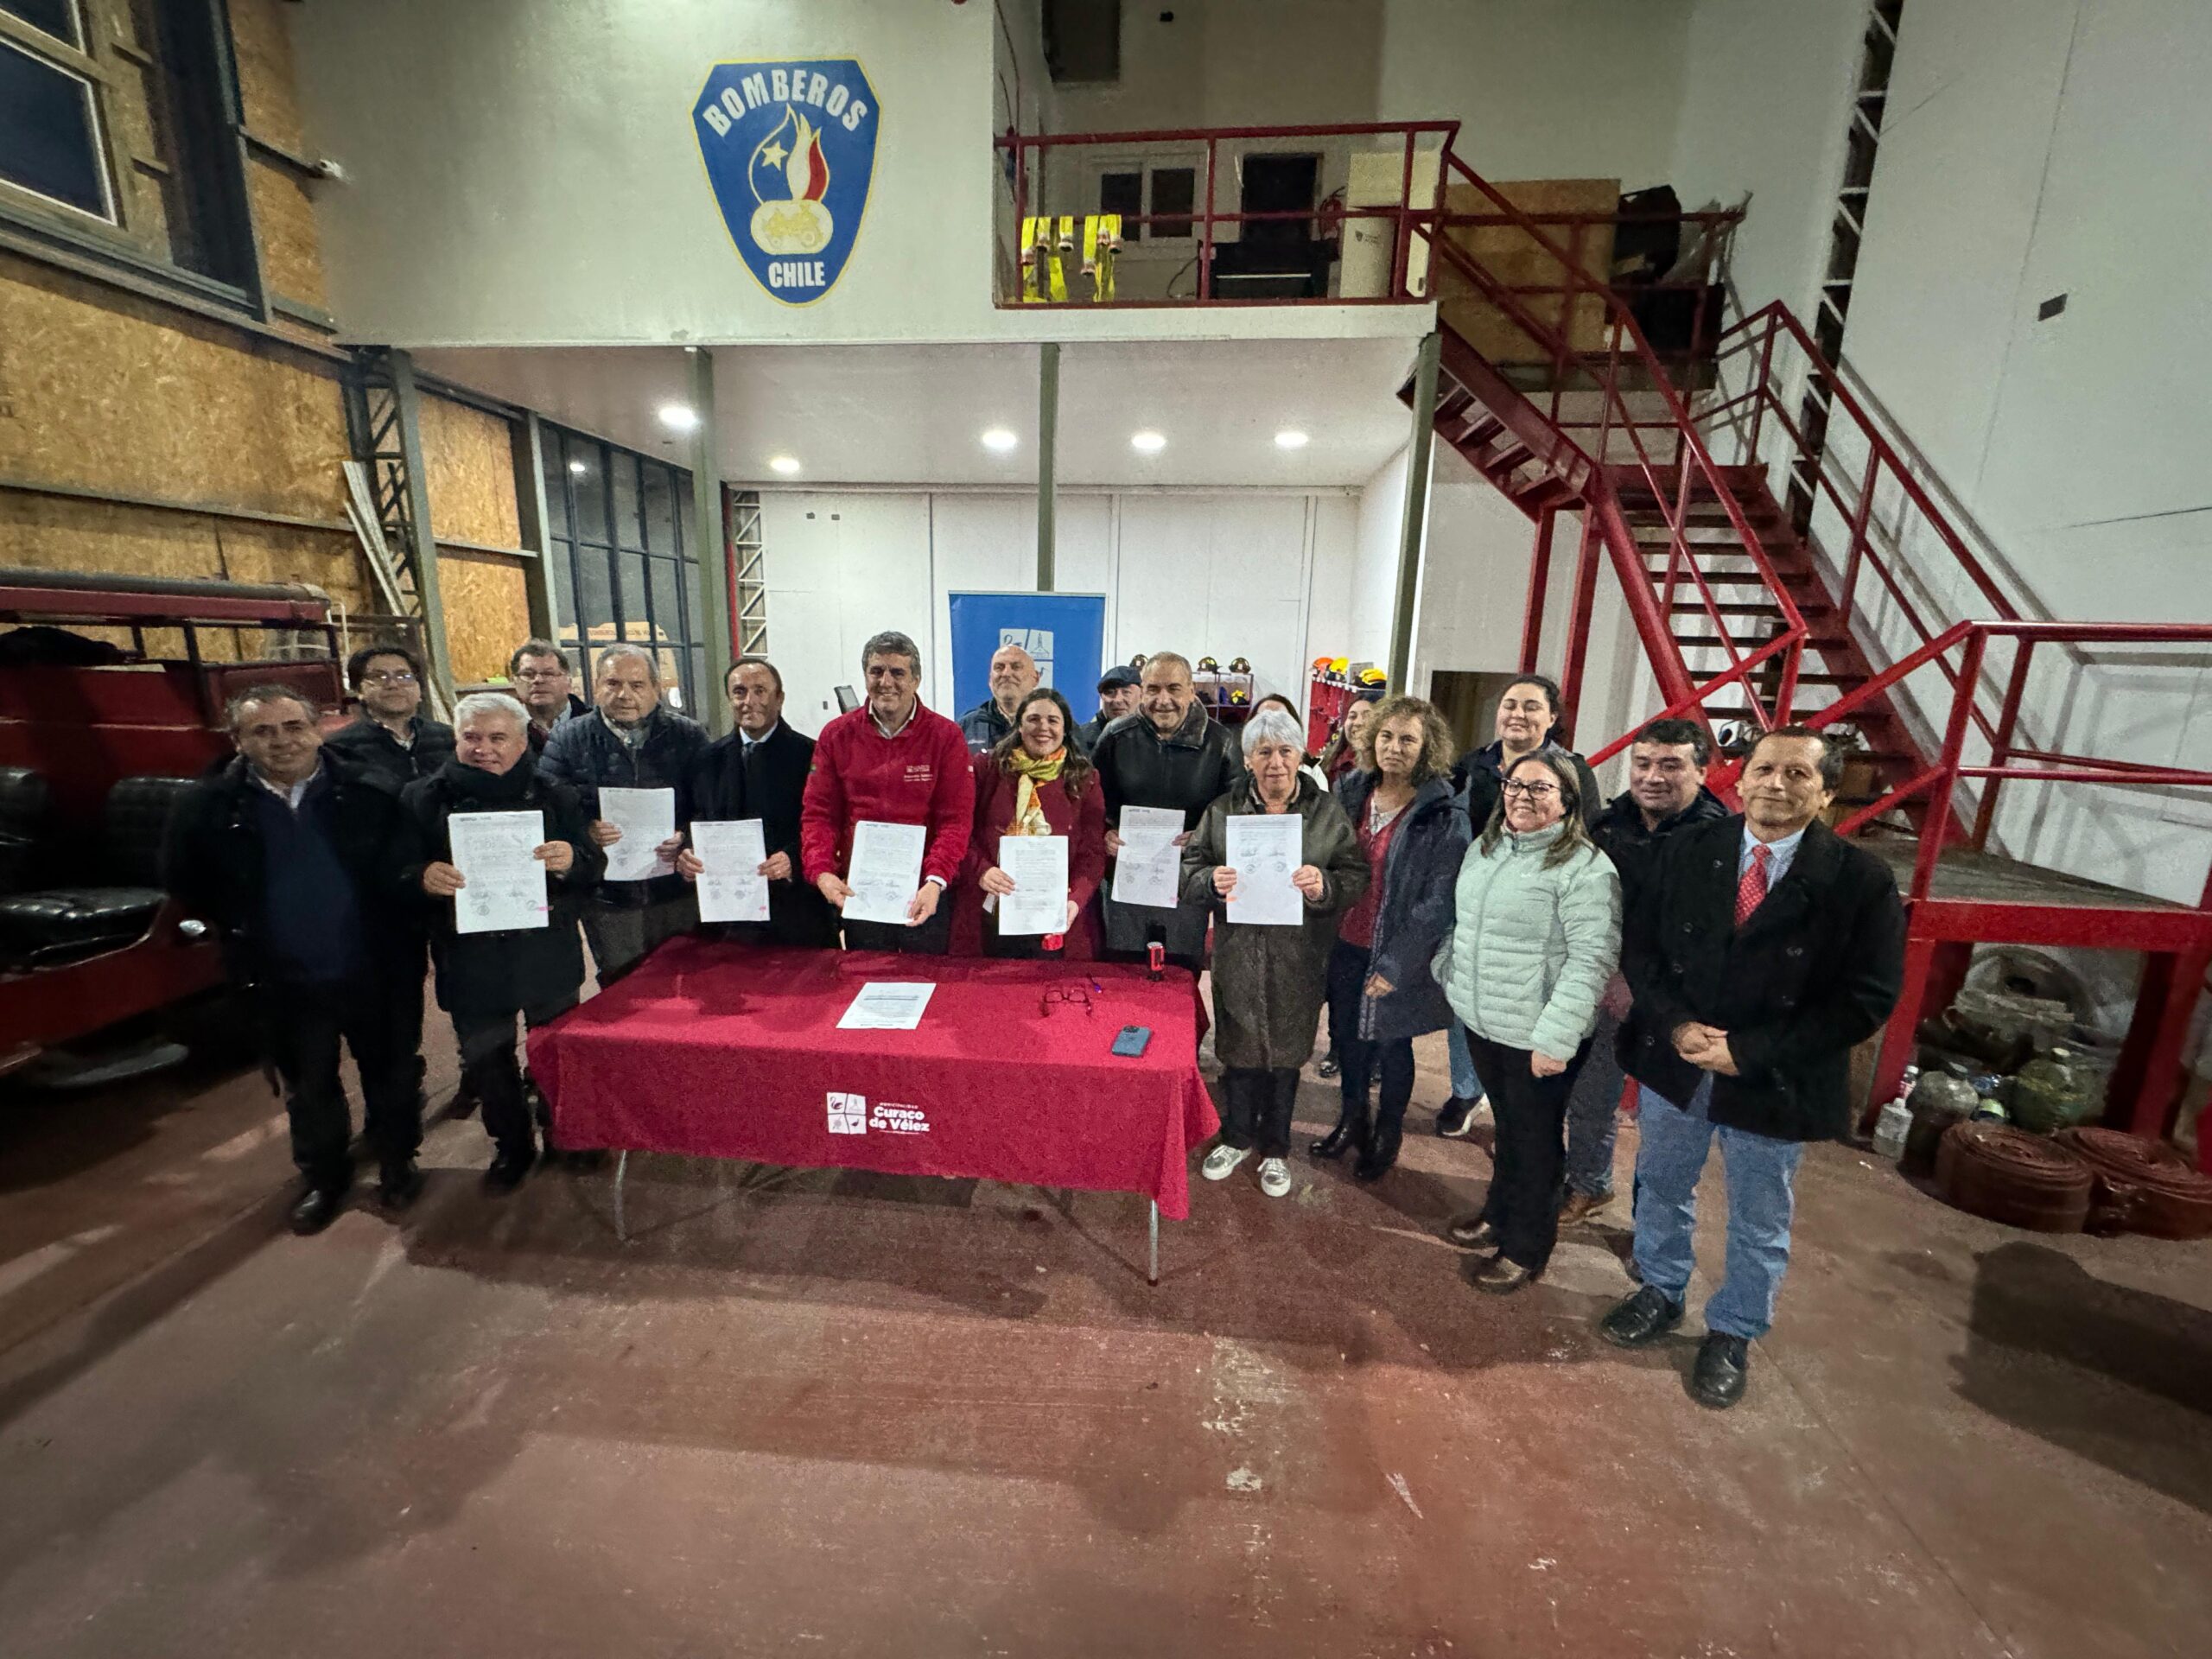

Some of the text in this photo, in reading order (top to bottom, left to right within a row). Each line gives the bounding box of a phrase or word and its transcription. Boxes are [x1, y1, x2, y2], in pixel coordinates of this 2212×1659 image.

[702, 69, 868, 137] BOMBEROS
[768, 262, 825, 288] CHILE
[874, 1106, 925, 1121] Curaco
[868, 1117, 930, 1132] de Vélez
